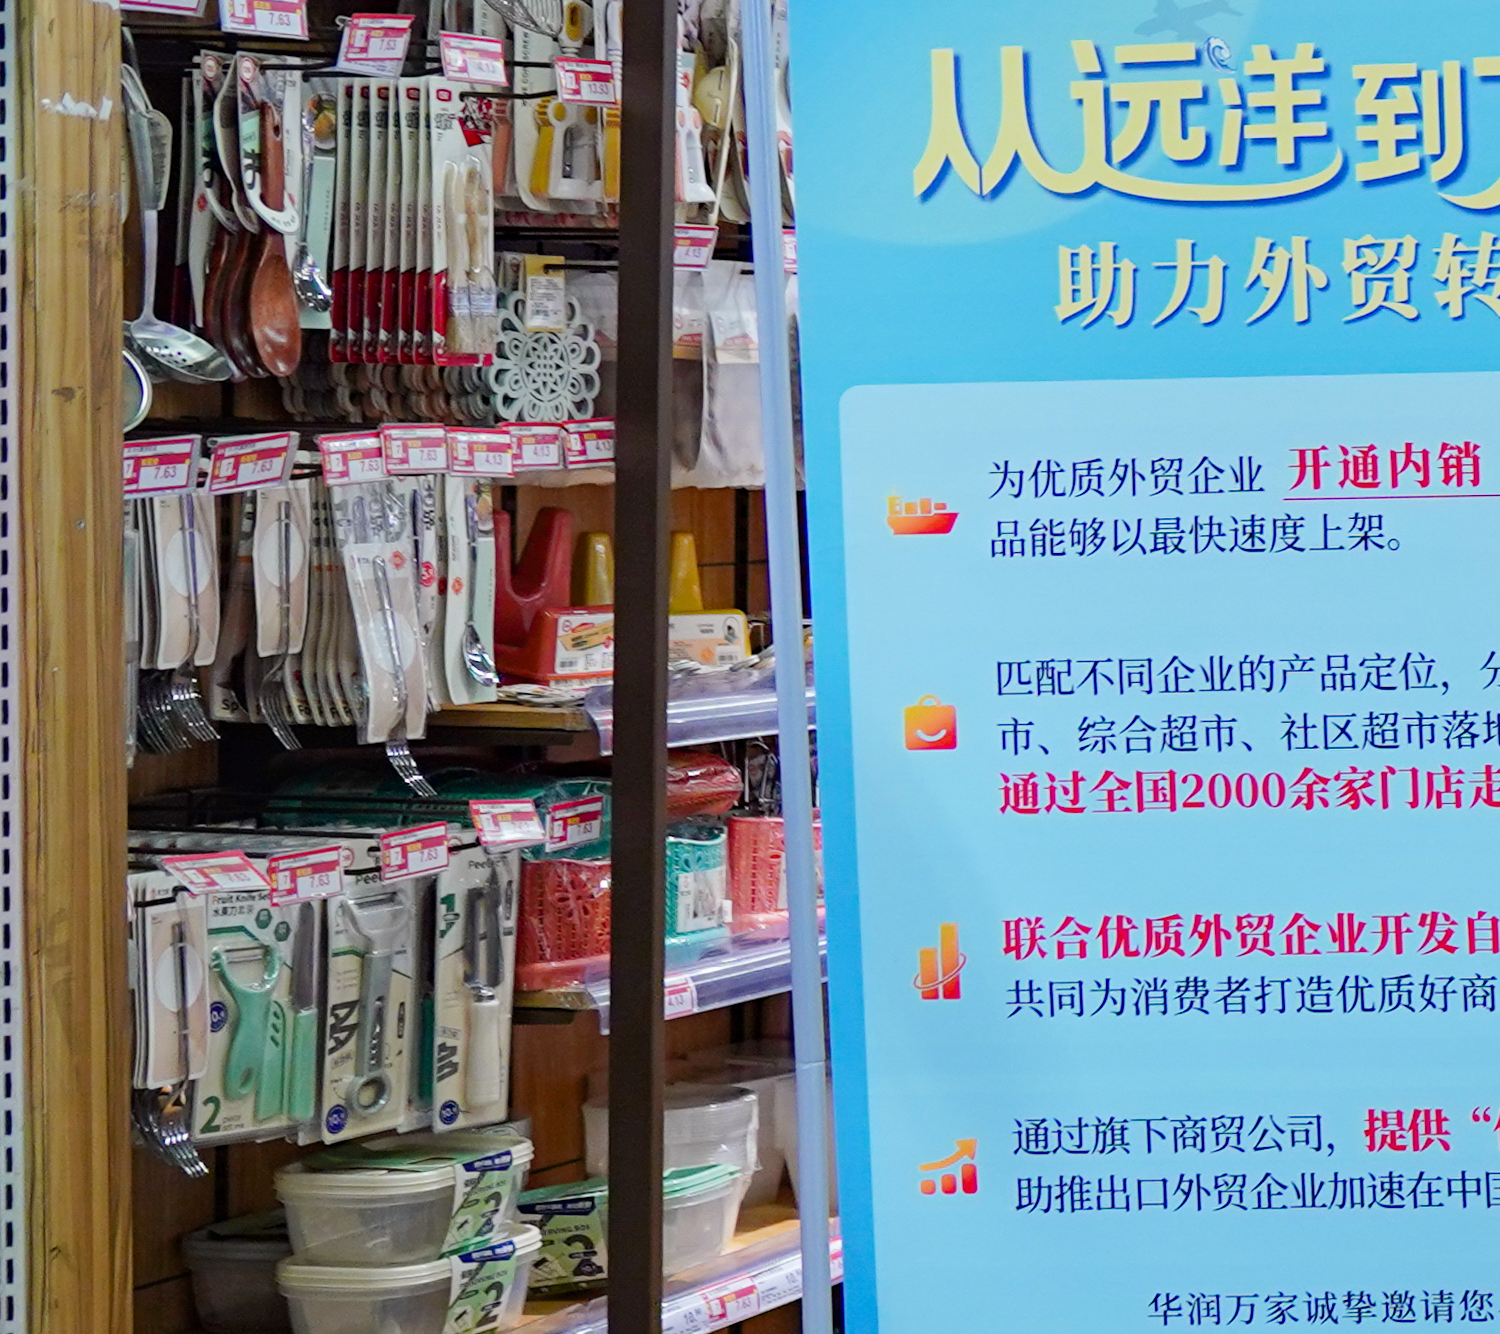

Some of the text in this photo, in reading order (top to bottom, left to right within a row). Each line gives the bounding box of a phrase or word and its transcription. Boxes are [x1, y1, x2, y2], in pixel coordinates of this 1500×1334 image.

[989, 512, 1405, 558] 品能够以最快速度上架。
